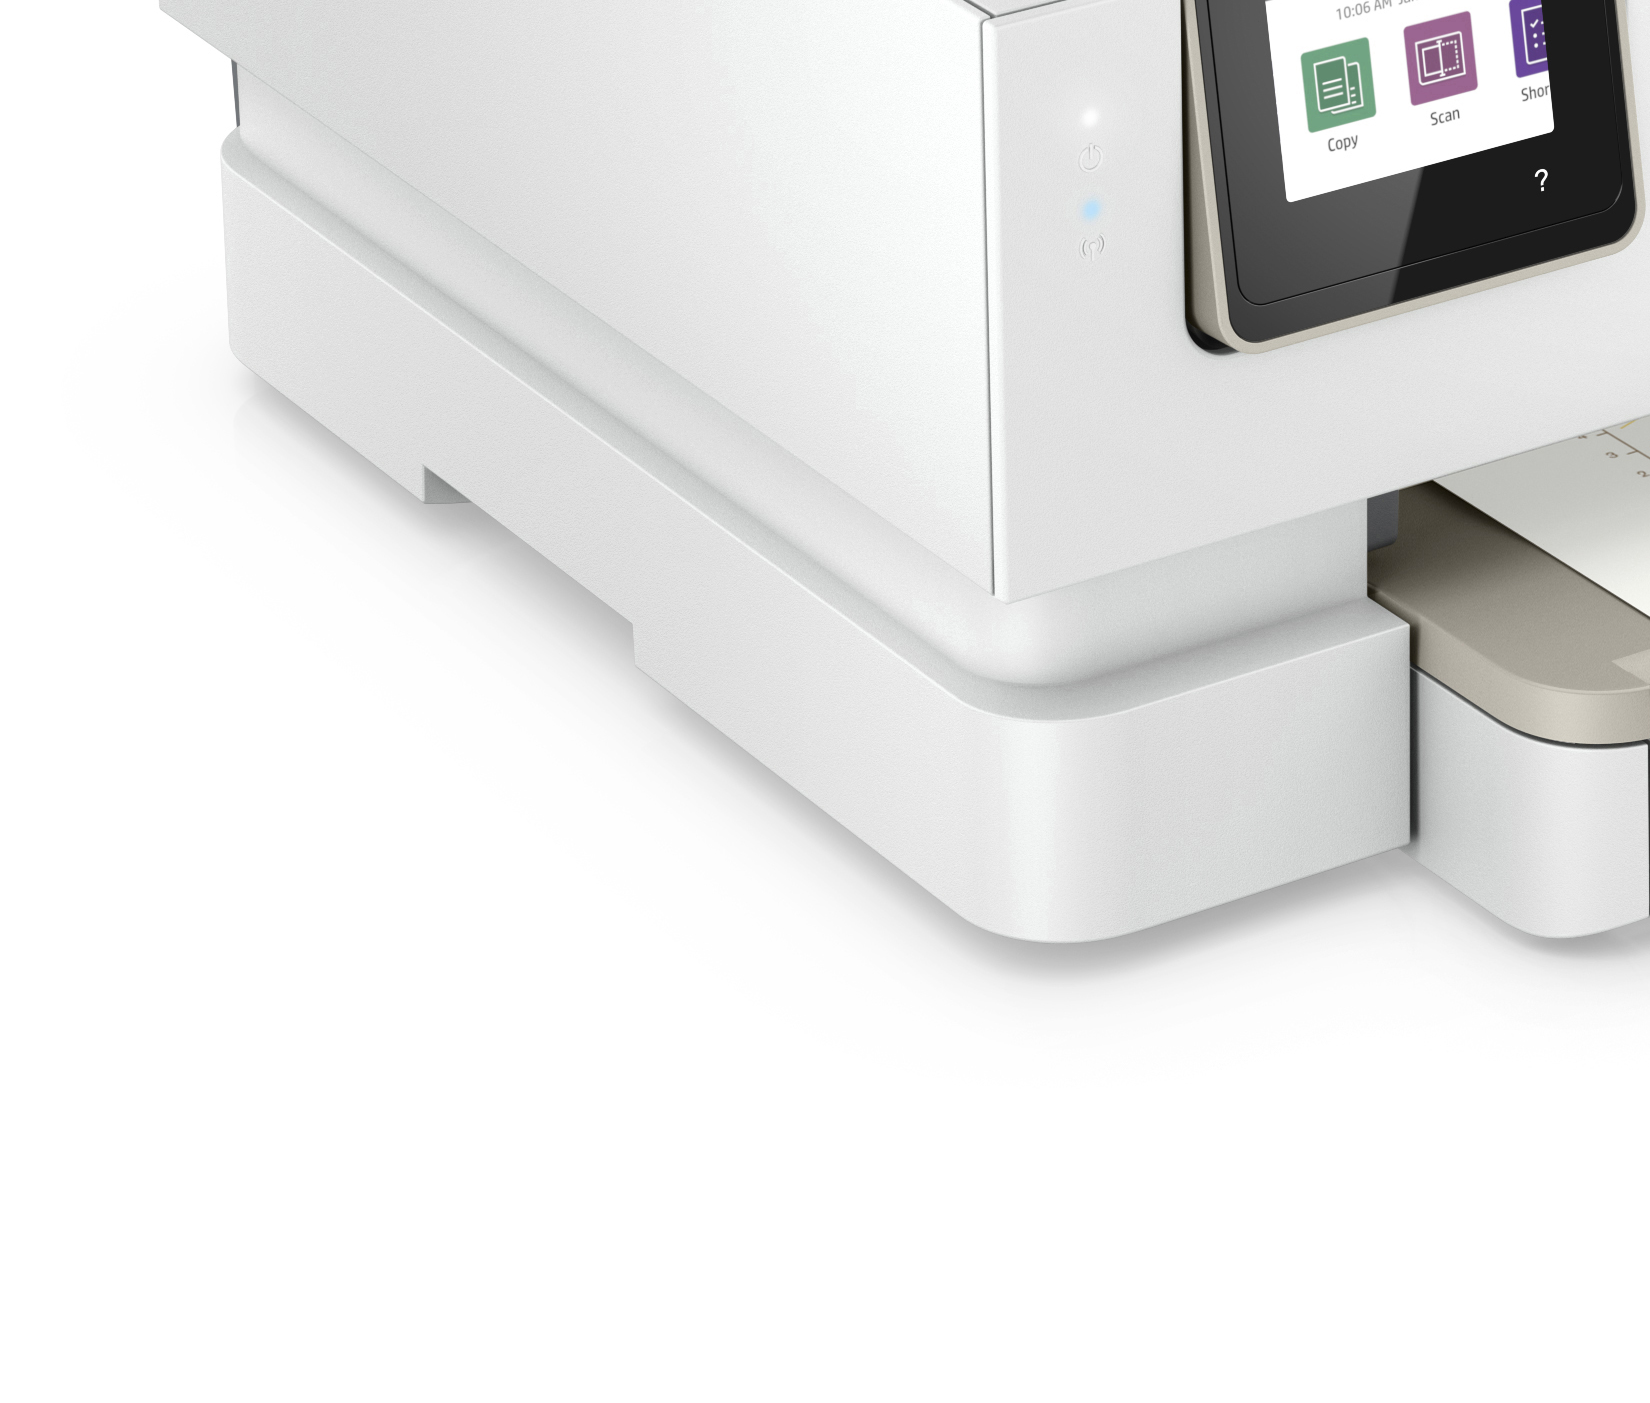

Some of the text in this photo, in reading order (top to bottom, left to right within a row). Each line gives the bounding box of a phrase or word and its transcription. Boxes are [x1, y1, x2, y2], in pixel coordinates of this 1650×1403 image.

[1336, 1, 1371, 20] 10:06
[1430, 108, 1461, 126] Scan
[1328, 135, 1359, 152] Copy
[1534, 168, 1549, 192] ?
[1605, 451, 1619, 459] 3
[1636, 470, 1650, 478] 2
